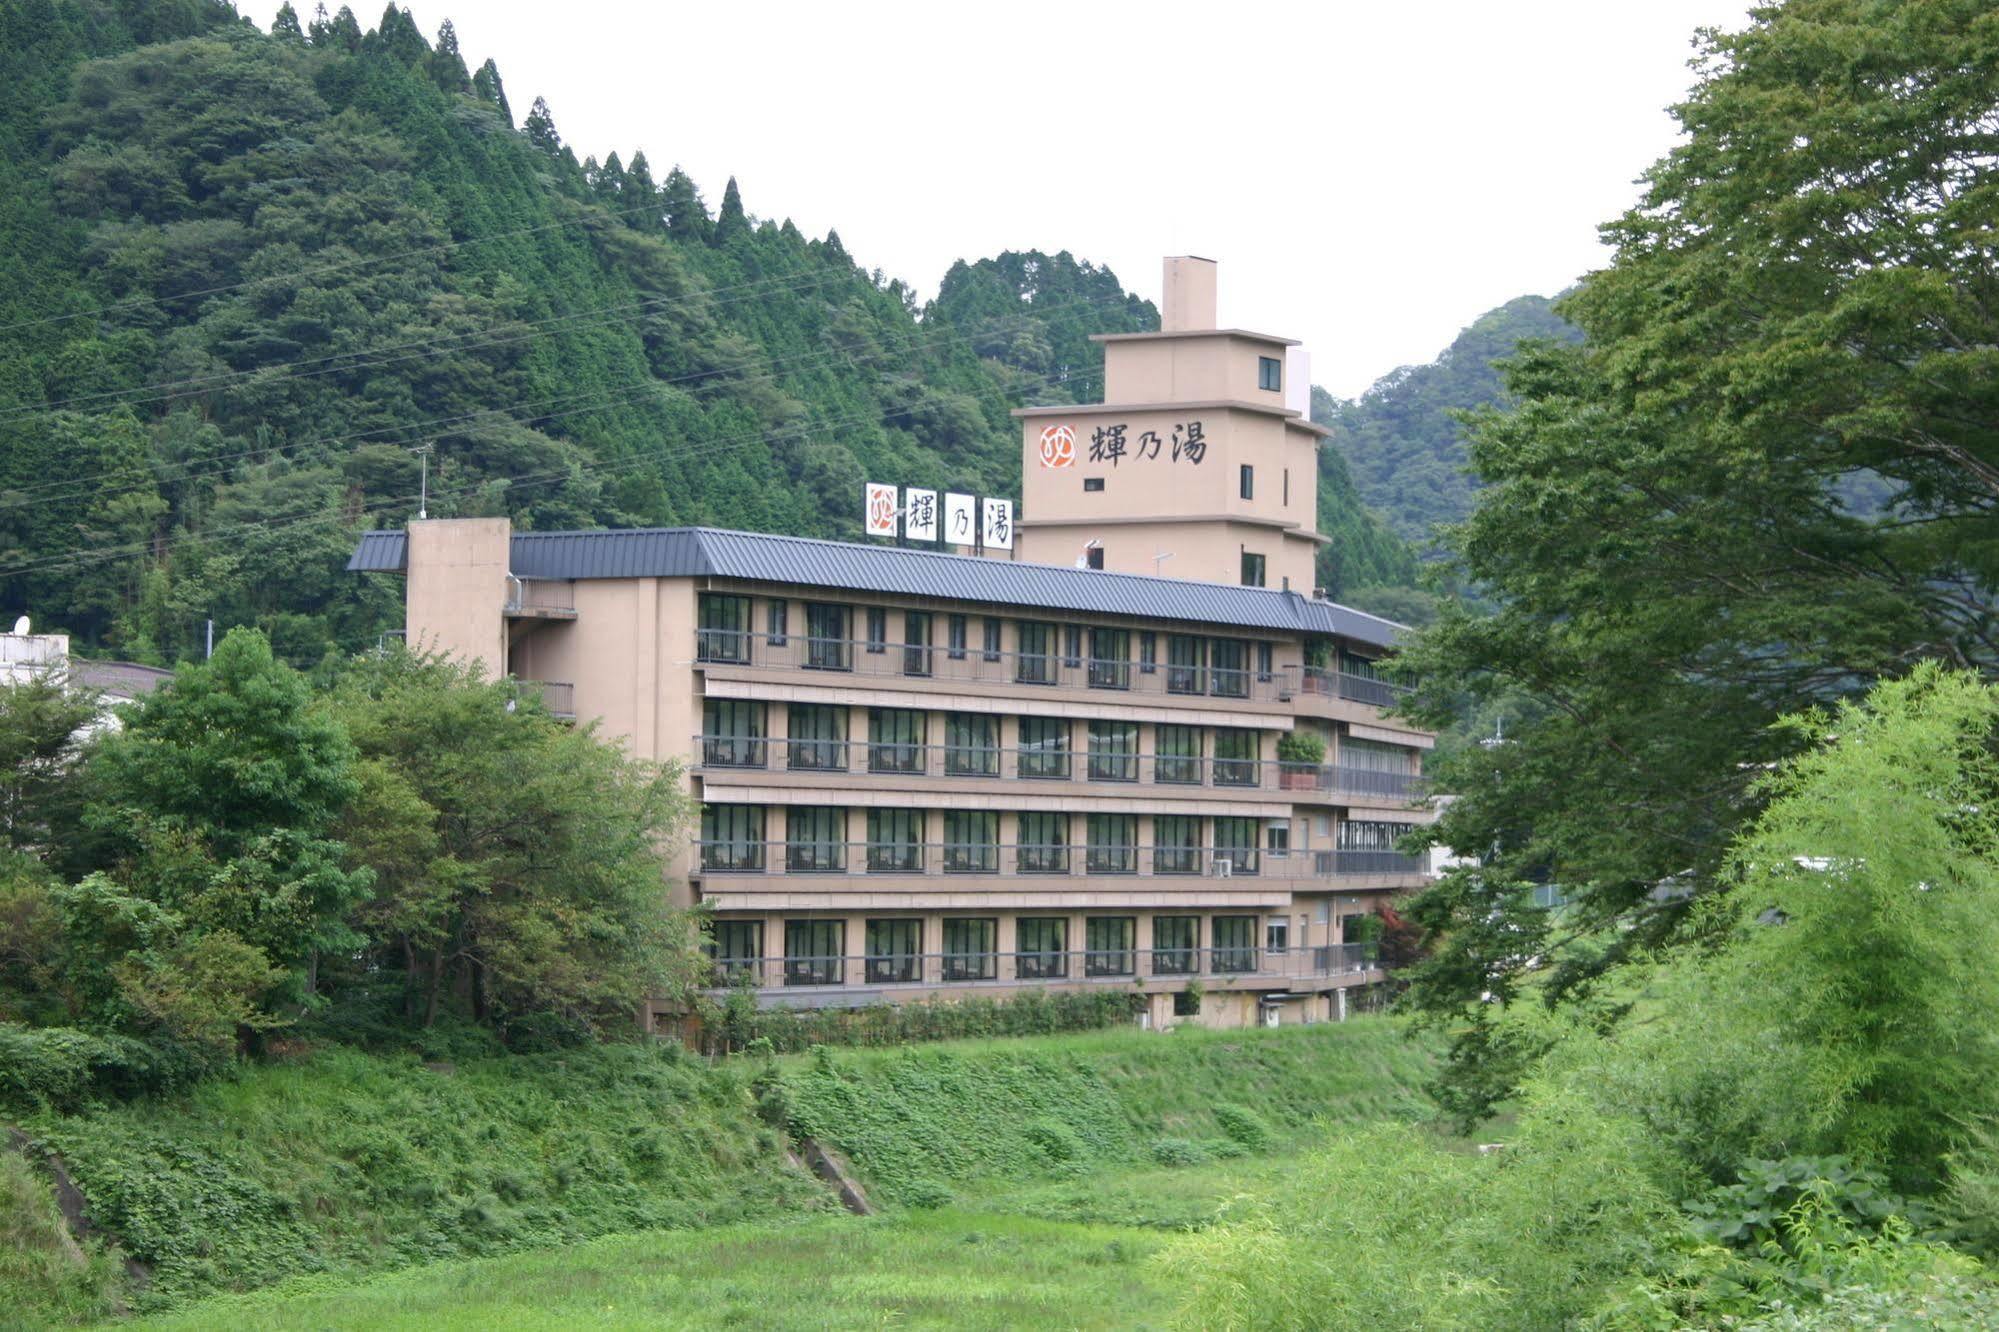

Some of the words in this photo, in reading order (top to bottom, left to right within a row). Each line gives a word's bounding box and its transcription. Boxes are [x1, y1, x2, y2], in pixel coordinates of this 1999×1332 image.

[1089, 421, 1207, 468] 輝乃湯
[909, 494, 1009, 544] 輝乃湯
